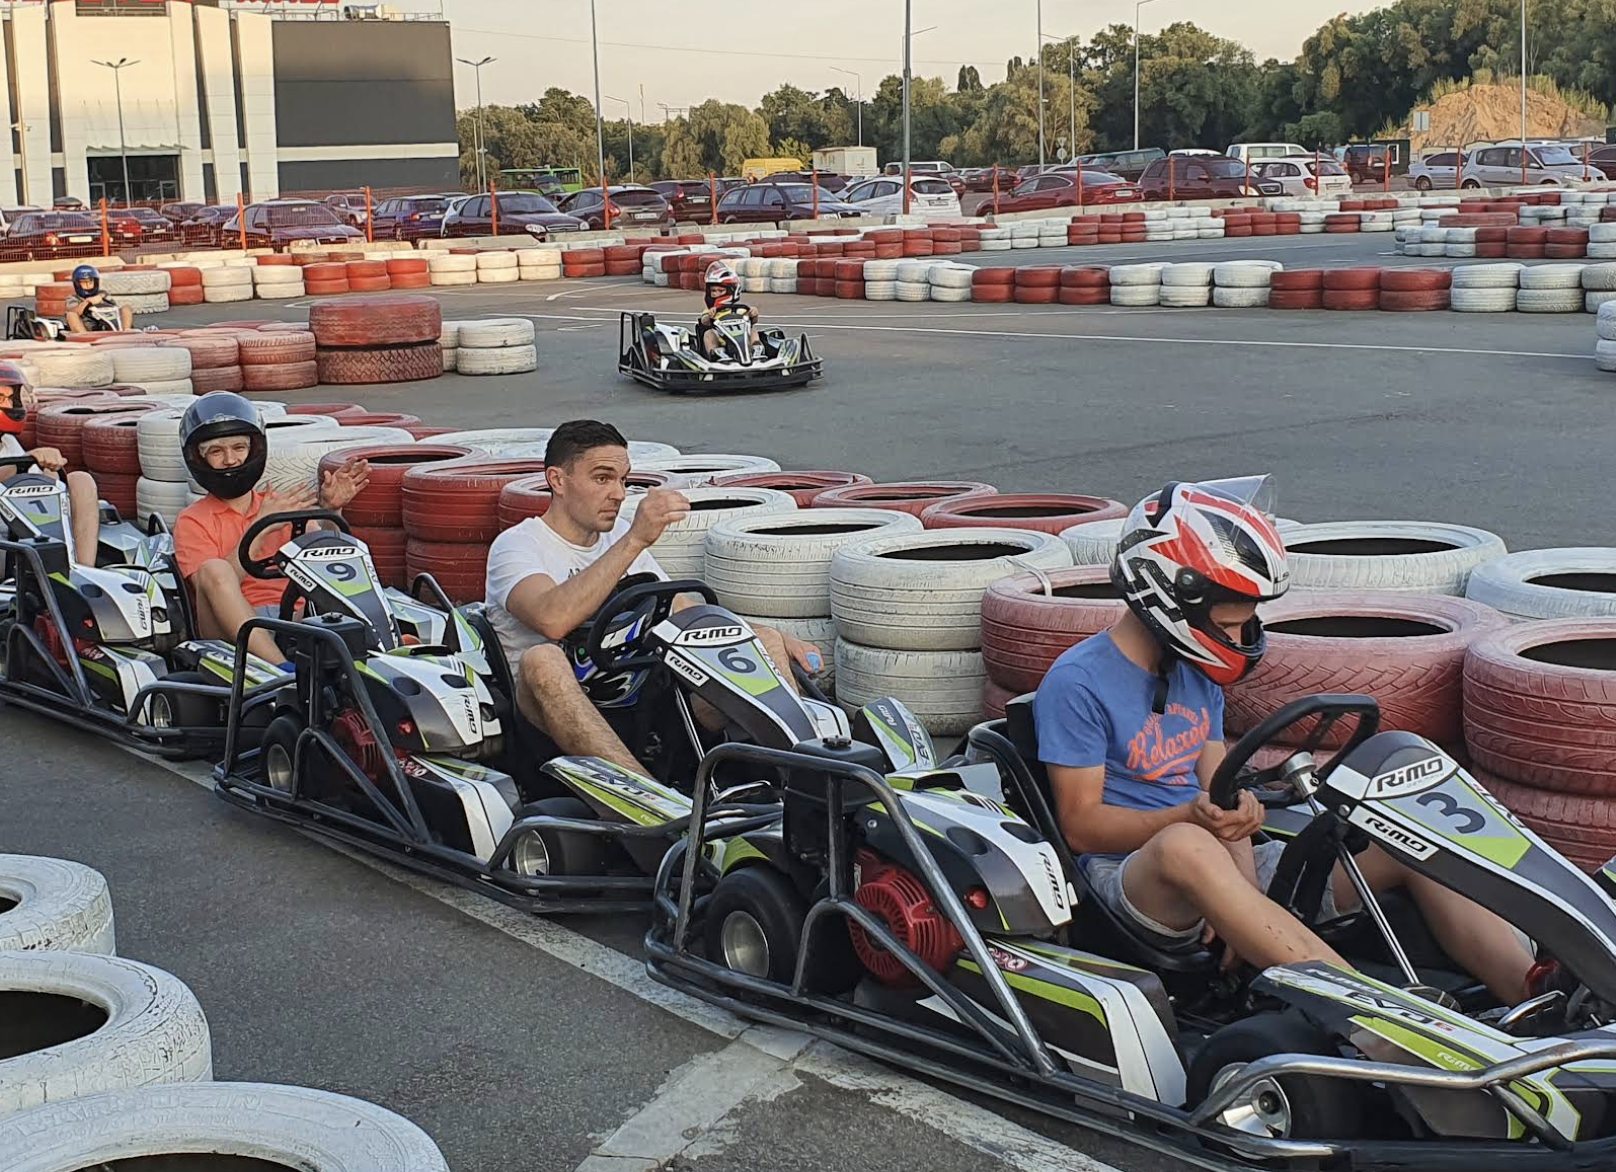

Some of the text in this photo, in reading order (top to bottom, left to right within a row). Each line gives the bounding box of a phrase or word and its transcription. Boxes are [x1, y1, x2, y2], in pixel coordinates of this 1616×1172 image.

[28, 500, 48, 514] 1
[326, 562, 357, 582] 9
[717, 647, 757, 674] 6
[1126, 707, 1210, 770] Relaxed
[1416, 791, 1486, 834] 3
